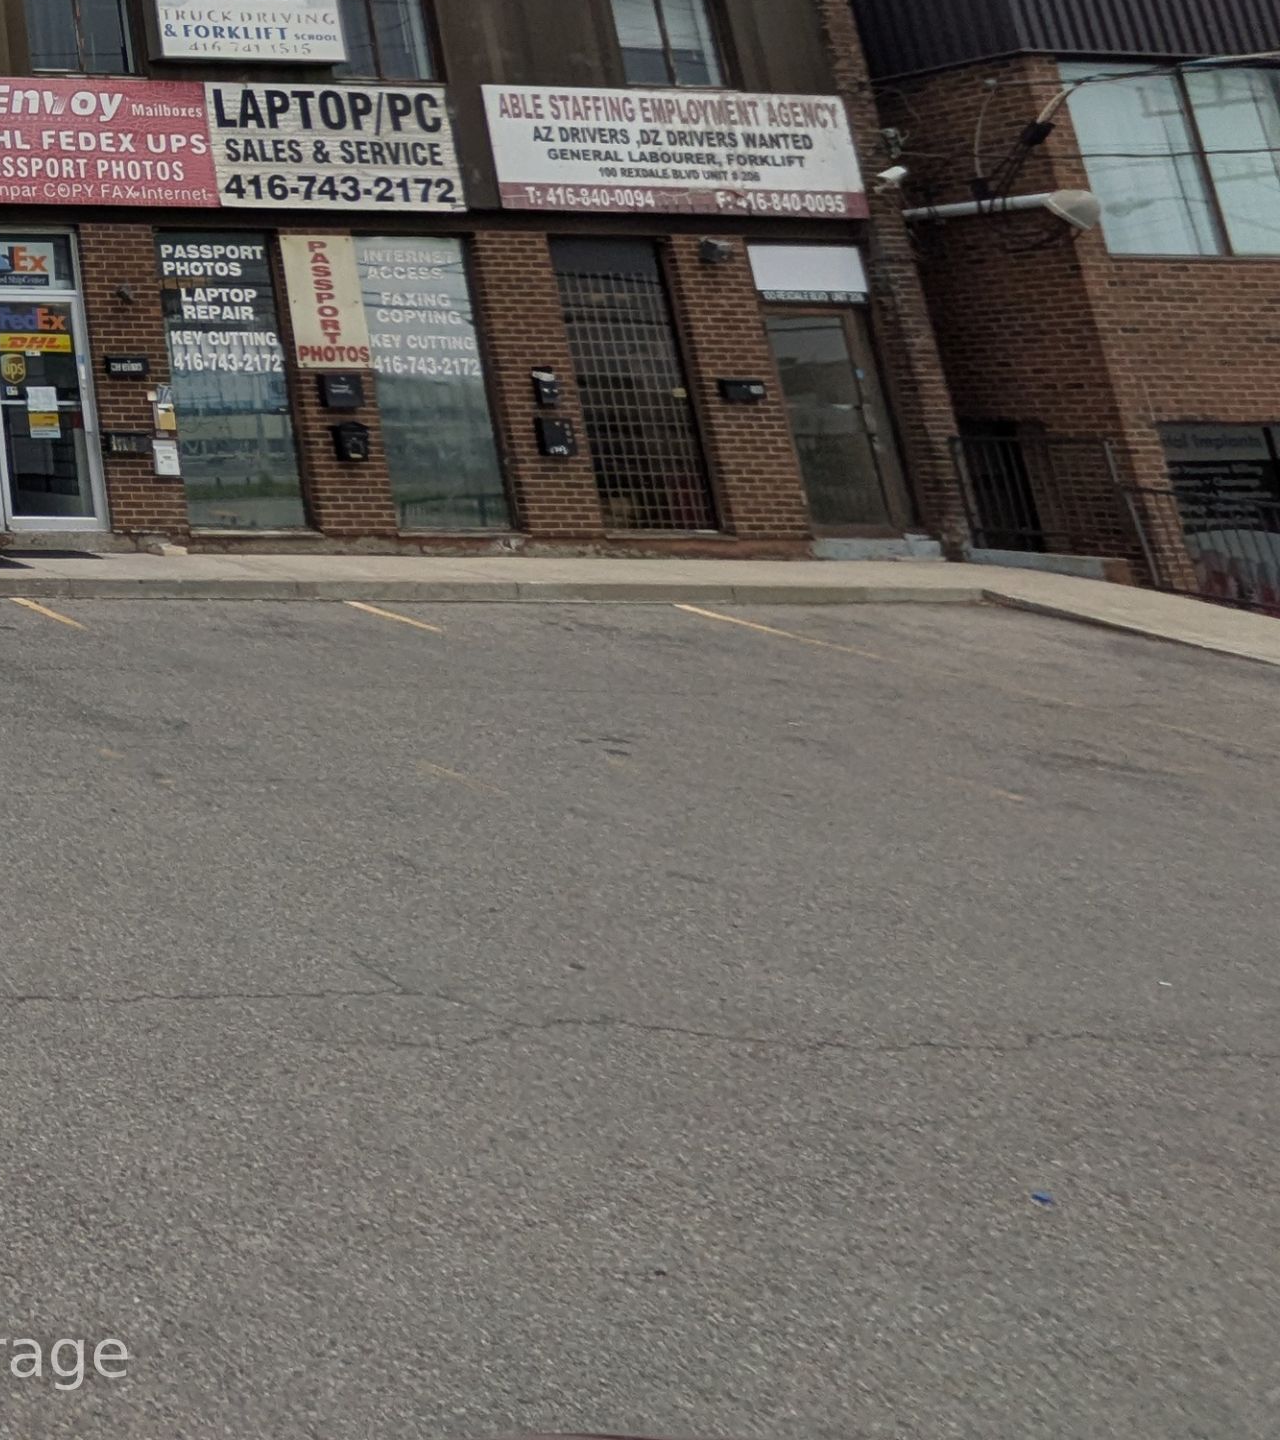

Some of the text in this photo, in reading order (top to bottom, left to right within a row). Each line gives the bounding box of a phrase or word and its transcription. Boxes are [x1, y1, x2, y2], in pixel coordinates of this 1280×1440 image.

[159, 8, 335, 25] TRUCK DRIVING
[164, 23, 337, 42] & FORKLIFT SCHOOL
[189, 41, 221, 52] 416
[132, 103, 202, 118] Mailboxes
[212, 89, 441, 136] LAPTOP/PC
[499, 93, 839, 129] ABLE STAFFING EMPLOYMENT AGENCY
[42, 131, 136, 153] FEDEX
[147, 134, 207, 155] UPS
[533, 126, 554, 142] AZ
[559, 127, 630, 144] DRIVERS
[667, 130, 739, 148] DRIVERS
[742, 132, 813, 150] WANTED
[225, 138, 443, 166] SALES & SERVICE
[547, 148, 805, 168] GENERAL LABOURER, FORKLIFT
[97, 159, 184, 181] PHOTOS
[599, 167, 618, 178] 100
[620, 168, 670, 179] REXDALE
[672, 169, 700, 180] BLVD
[703, 170, 728, 181] UNIT
[44, 183, 94, 198] COPY
[101, 184, 134, 198] FAX
[225, 174, 456, 203] 416-743-2172
[525, 186, 542, 204] T:
[546, 187, 655, 208] 416-840-0094
[160, 244, 264, 260] PASSPORT
[362, 249, 455, 264] INTERNET
[162, 261, 242, 277] PHOTOS
[367, 266, 443, 280] ACCESS
[180, 288, 257, 303] LAPTOP
[307, 240, 341, 344] PASSPORT
[381, 292, 451, 308] FAXING
[182, 305, 254, 320] REPAIR
[376, 309, 462, 325] COPYING
[7, 337, 60, 349] DHL
[170, 330, 279, 346] KEY CUTTING
[371, 333, 477, 350] KEY CUTTING
[174, 352, 283, 372] 416-743-2172
[299, 345, 370, 363] PHOTOS
[5, 363, 24, 378] ups
[374, 355, 481, 376] 416-743-2172
